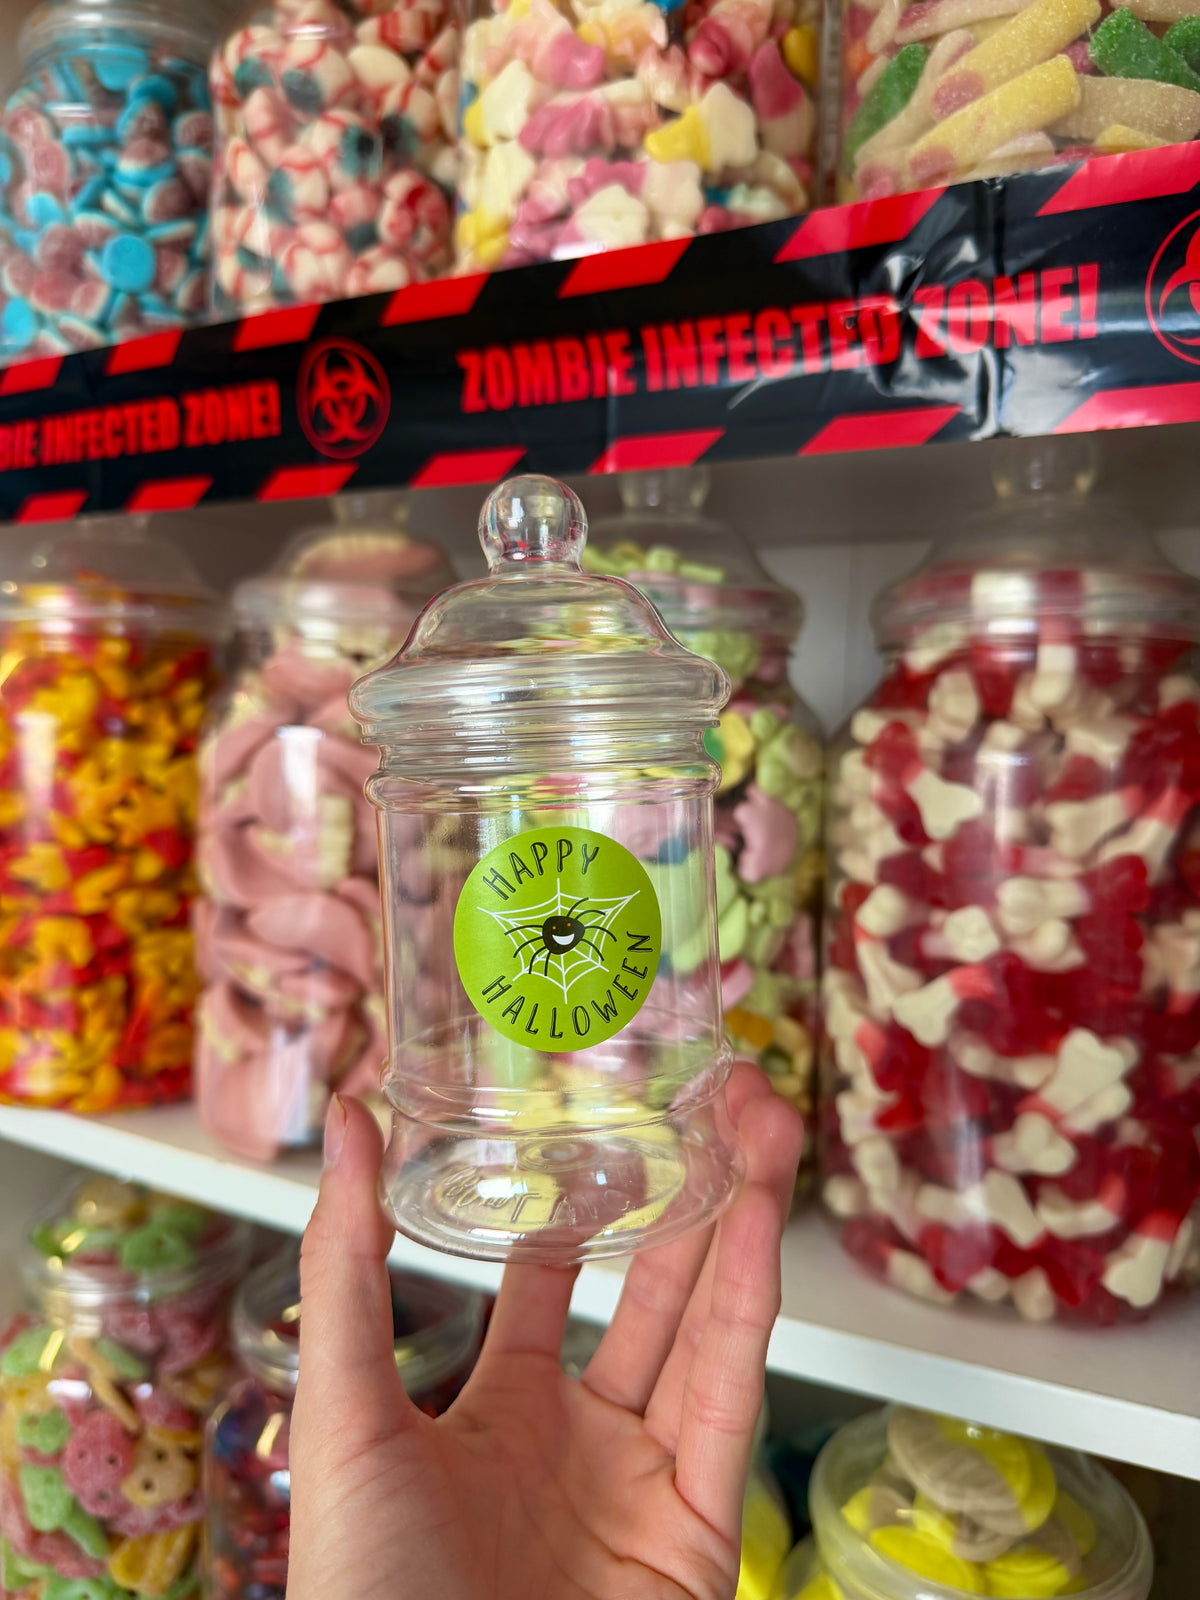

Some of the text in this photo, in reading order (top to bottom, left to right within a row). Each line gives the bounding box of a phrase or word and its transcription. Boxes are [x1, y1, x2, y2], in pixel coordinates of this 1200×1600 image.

[457, 263, 1099, 414] ZOMBIE INFECTED ZONE!
[40, 396, 180, 466] INFECTED
[182, 378, 282, 447] ZONE!
[482, 838, 600, 901] HAPPY
[481, 931, 654, 1039] HALLOWEEN
